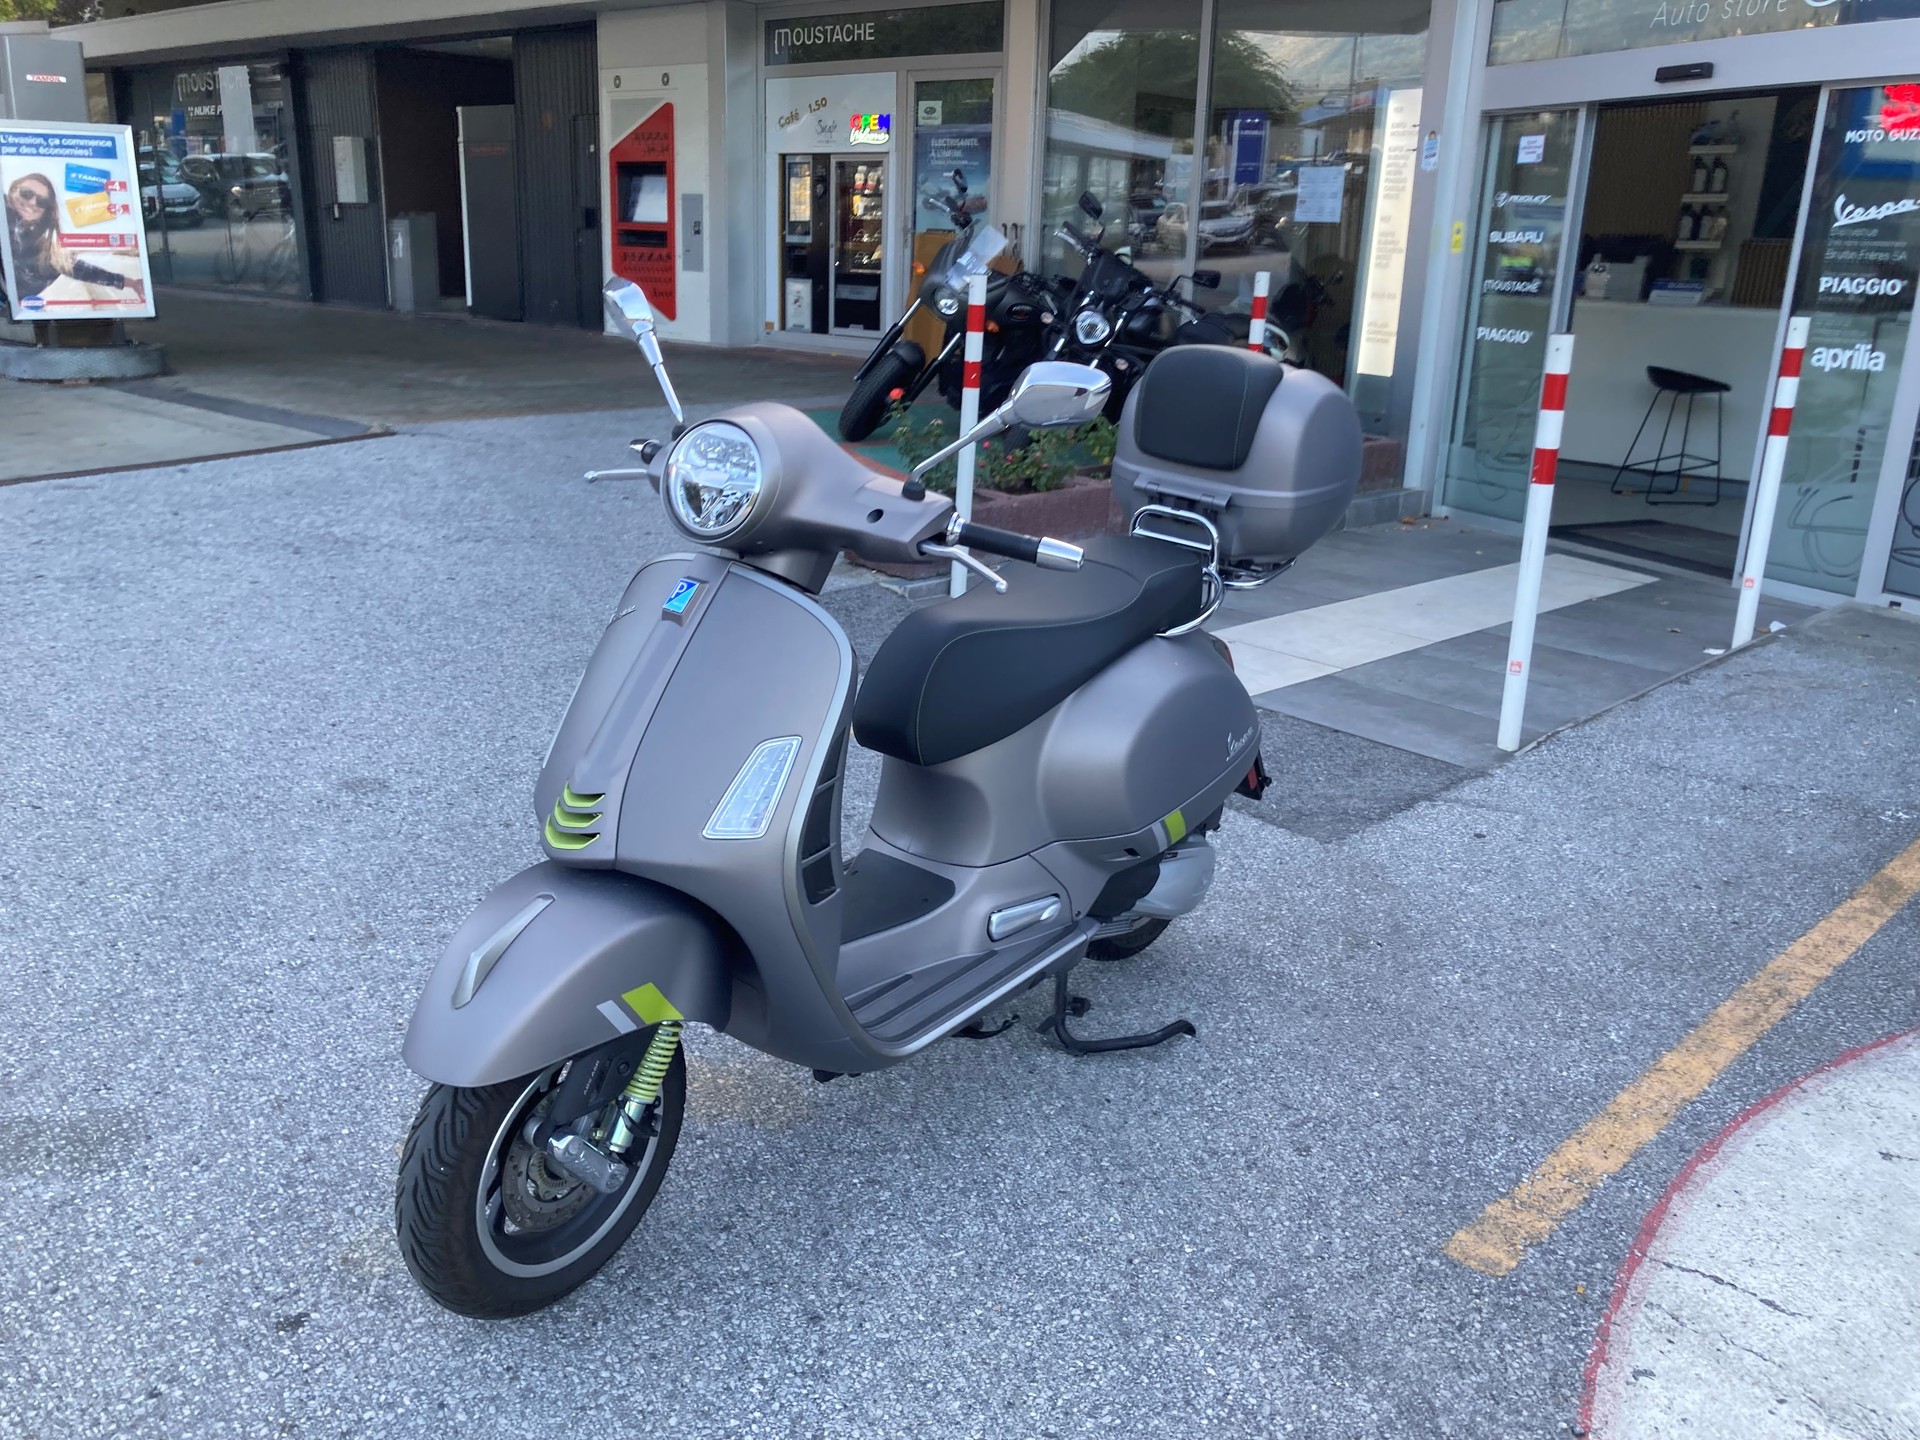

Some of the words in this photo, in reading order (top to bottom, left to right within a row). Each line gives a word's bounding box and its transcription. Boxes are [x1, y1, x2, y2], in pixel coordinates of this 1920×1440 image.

[1650, 2, 1710, 29] Auto
[1721, 0, 1787, 19] store
[775, 22, 875, 55] MOUSTACHE
[31, 74, 60, 82] TAMOIL
[194, 105, 216, 116] NUKE
[778, 108, 800, 128] Café
[808, 96, 828, 114] 1.50
[849, 113, 891, 131] OPEN
[0, 134, 47, 148] L'évasion,
[48, 137, 60, 146] ça
[62, 137, 113, 148] commence
[1845, 129, 1886, 144] MOTO
[1888, 127, 1920, 142] GUZ
[1, 146, 18, 156] par
[19, 146, 37, 155] des
[39, 146, 93, 157] économies!
[1832, 193, 1920, 228] Vespa
[1489, 231, 1544, 243] SUBARU
[1483, 279, 1540, 294] MOUSTACHE
[1818, 276, 1903, 296] PIAGGIO
[1476, 326, 1530, 344] PIAGGIO
[1810, 343, 1886, 373] aprilia
